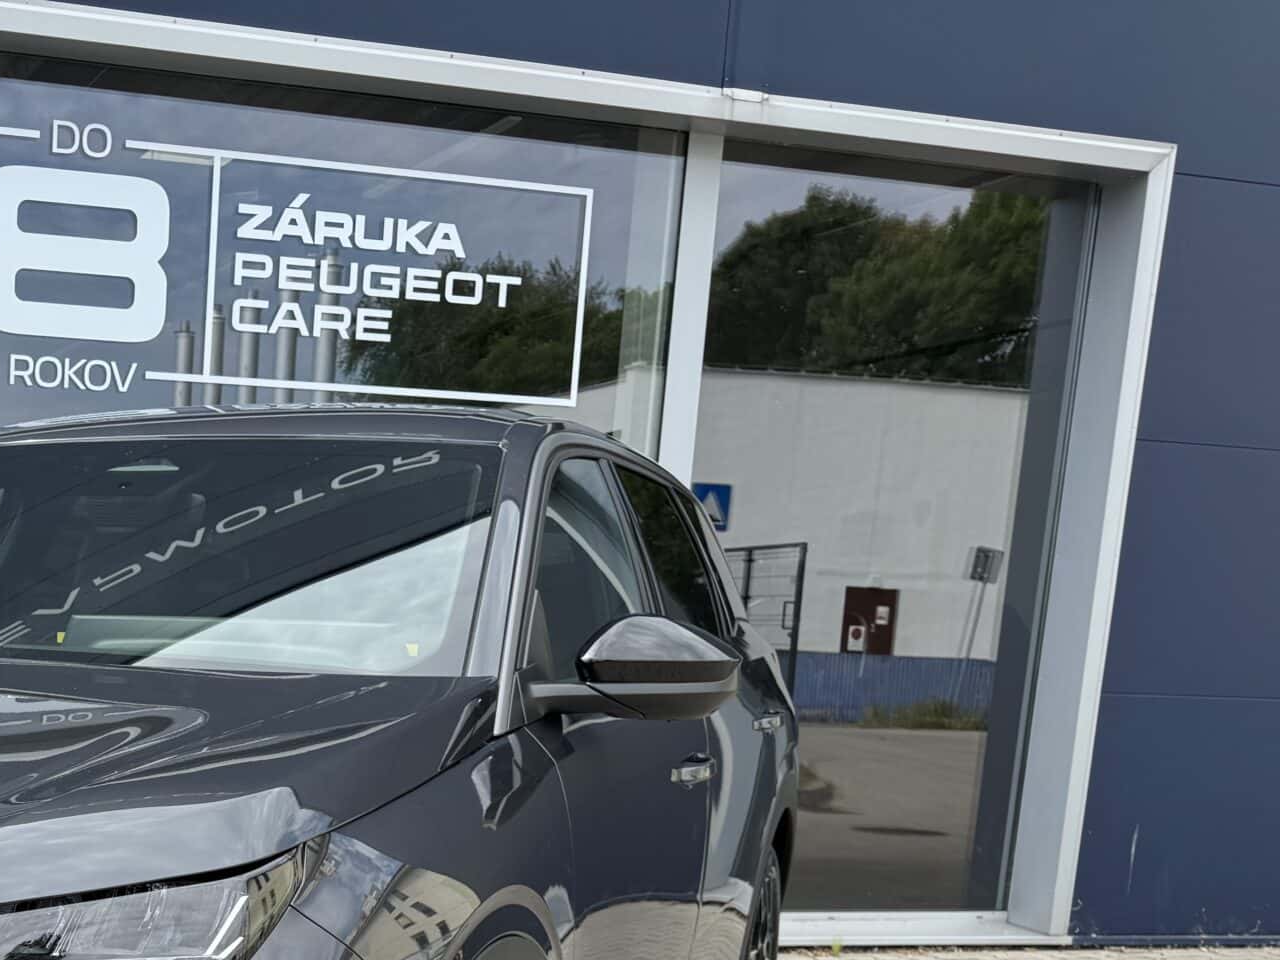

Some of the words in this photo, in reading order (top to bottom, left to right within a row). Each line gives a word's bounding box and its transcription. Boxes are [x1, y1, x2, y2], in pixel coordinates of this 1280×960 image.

[52, 119, 113, 158] DO
[236, 192, 467, 259] ZÁRUKA
[233, 252, 522, 308] PEUGEOT
[231, 297, 393, 342] CARE
[9, 353, 138, 393] ROKOV
